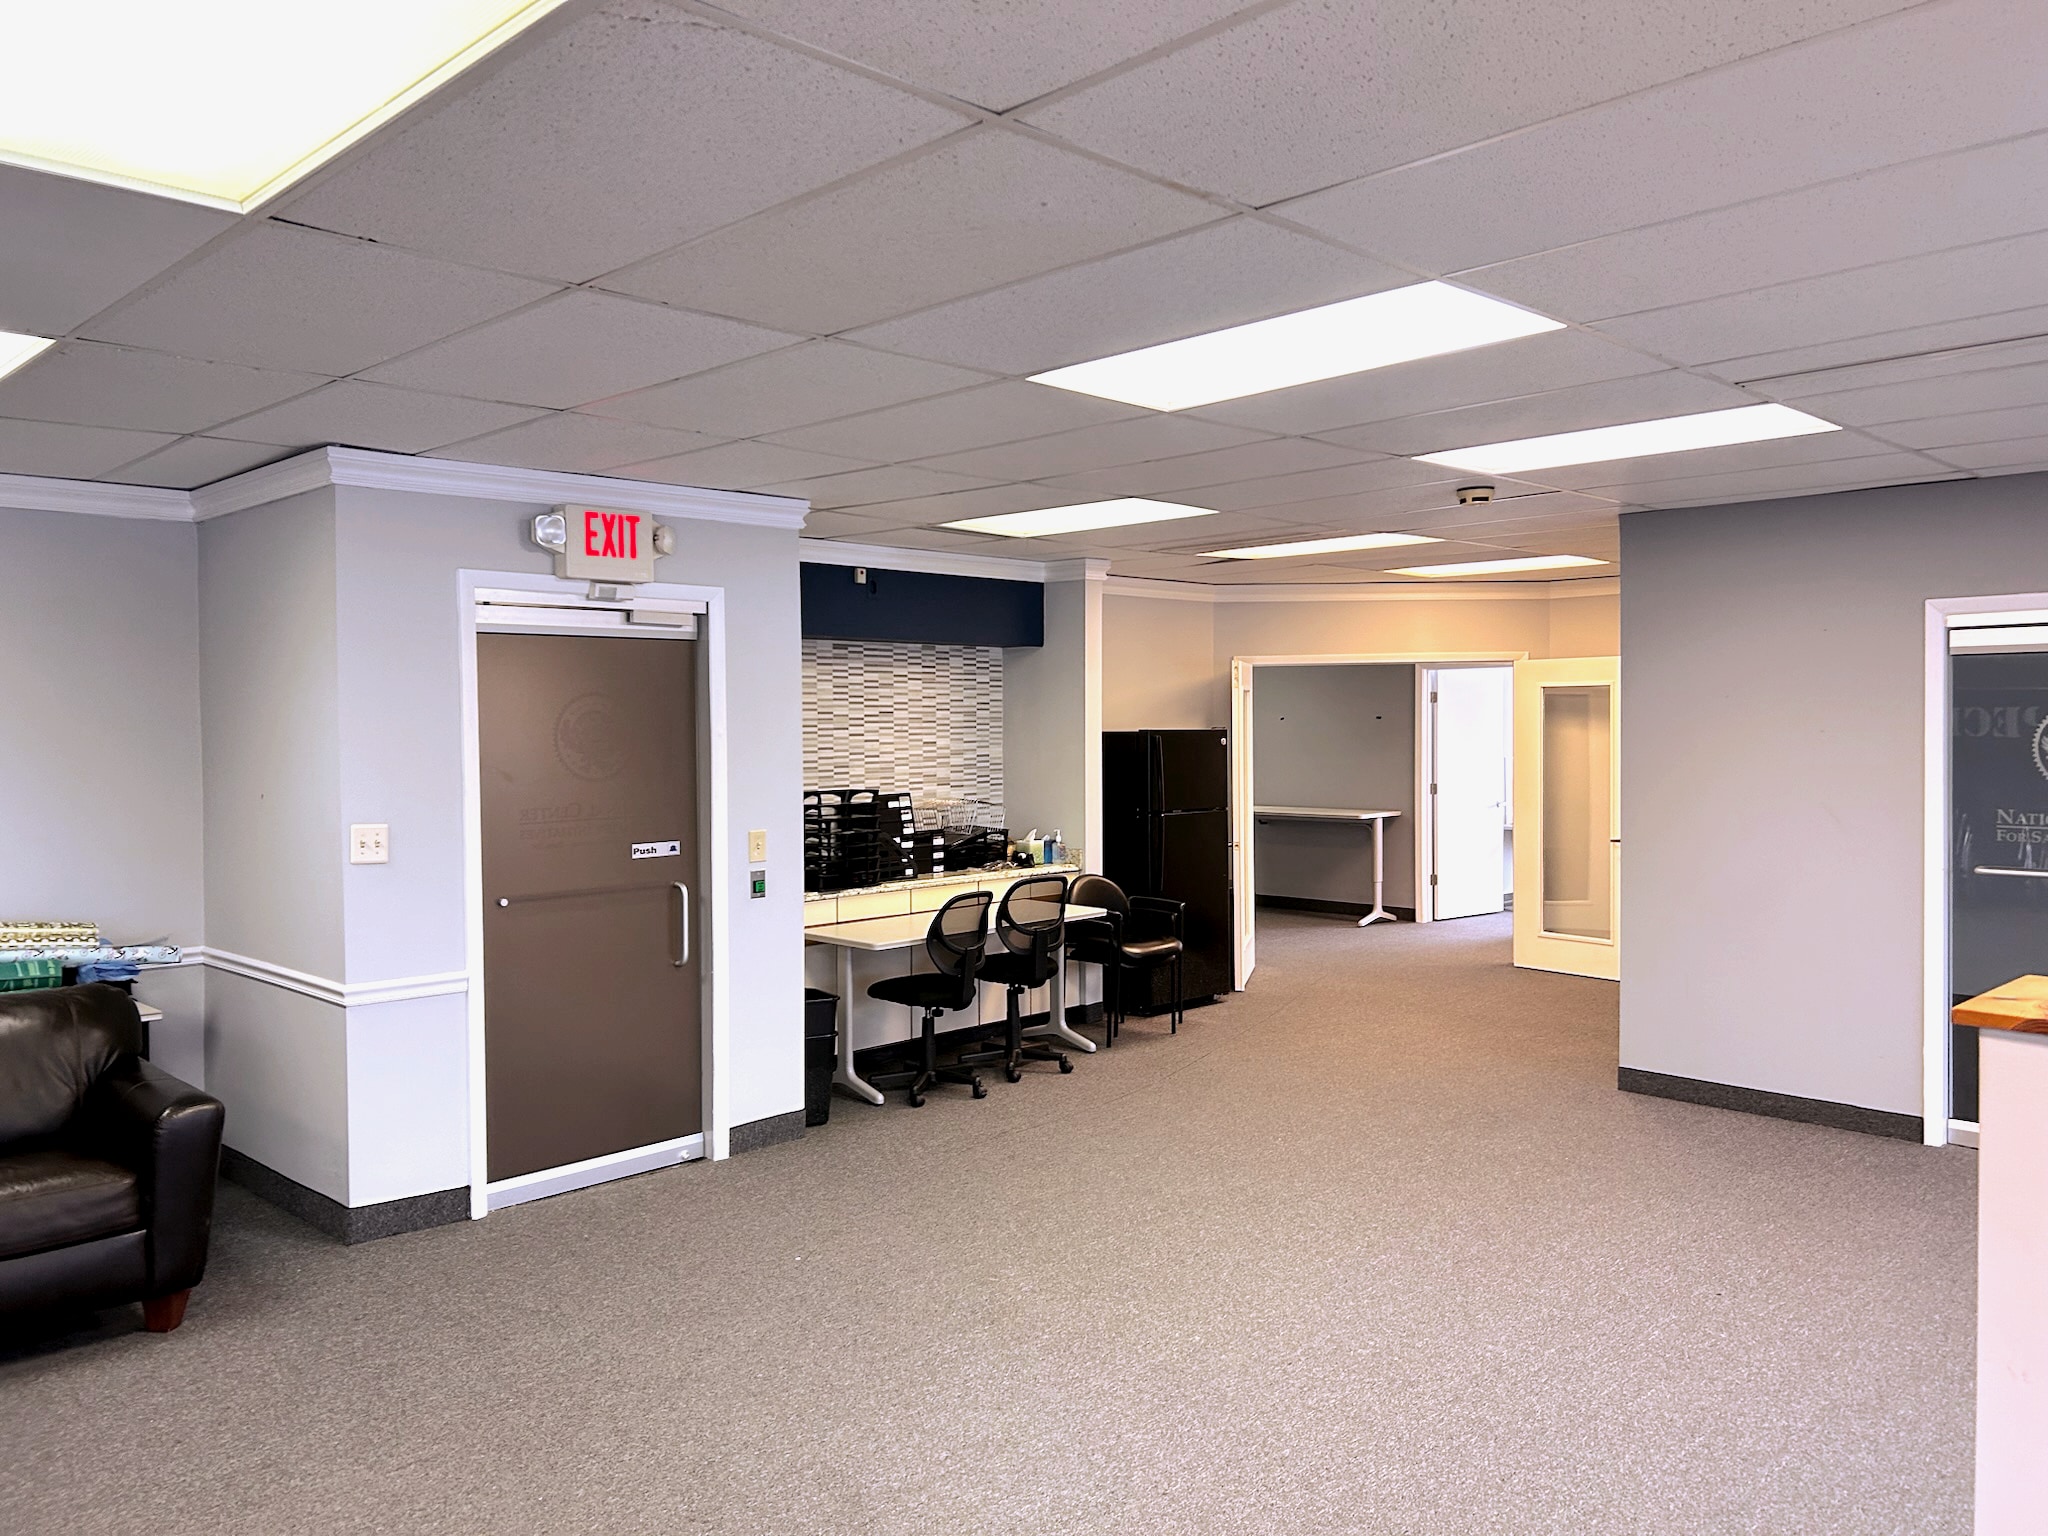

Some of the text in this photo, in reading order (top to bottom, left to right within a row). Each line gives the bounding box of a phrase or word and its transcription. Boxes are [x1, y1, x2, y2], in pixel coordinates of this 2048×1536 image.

[584, 511, 641, 560] EXIT
[1996, 808, 2048, 825] NATI
[1996, 829, 2028, 842] FOR
[633, 846, 657, 855] Push
